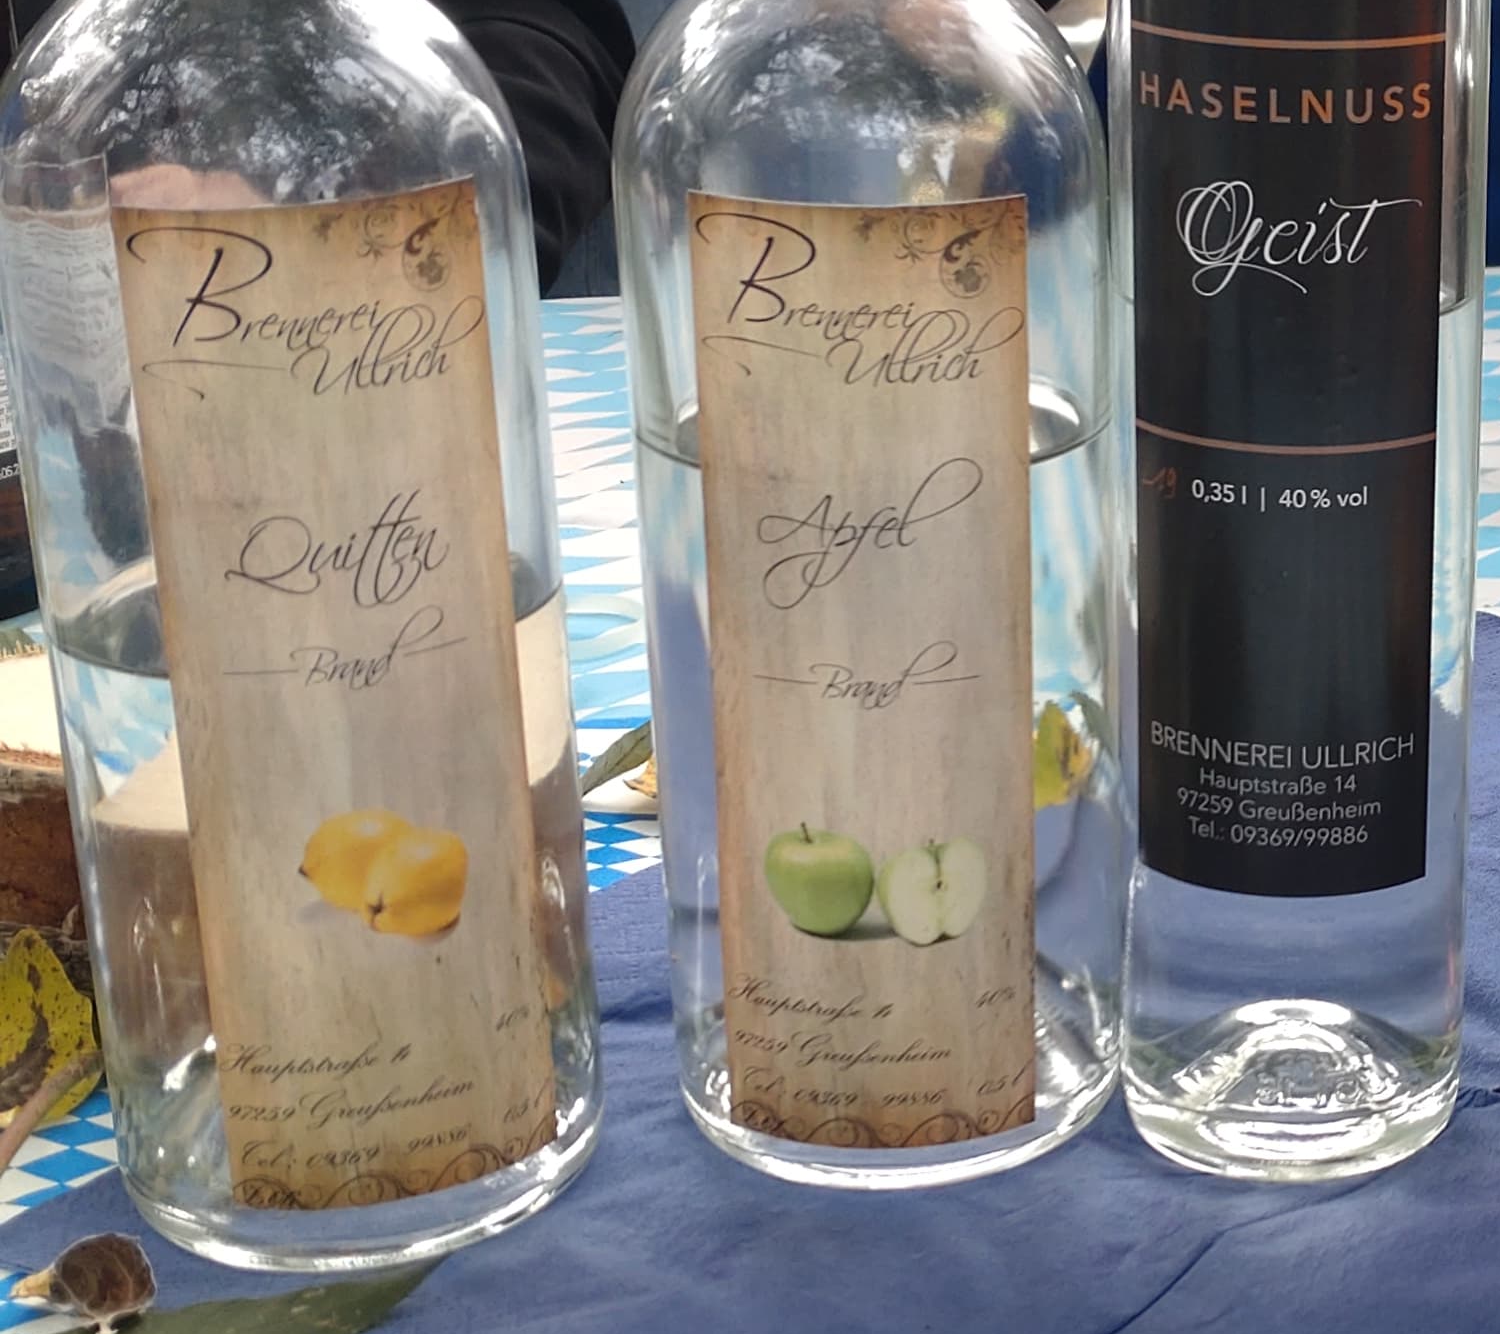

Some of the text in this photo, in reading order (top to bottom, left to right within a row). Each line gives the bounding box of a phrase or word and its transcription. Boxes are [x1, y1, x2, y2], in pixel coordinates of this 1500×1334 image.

[1139, 71, 1432, 124] HASELNUSS
[695, 211, 915, 342] Brennerei
[1176, 180, 1423, 297] Geist
[126, 227, 380, 351] Brennerei
[288, 295, 486, 397] Ullrich
[825, 306, 1026, 388] Ullrich
[757, 457, 984, 611] Apfel
[1191, 478, 1237, 506] 0,35
[1336, 485, 1369, 508] vol
[224, 488, 452, 609] Quitten
[1151, 720, 1415, 769] BRENNEREI ULLRICH
[1199, 767, 1358, 797] Hauptstraße 14
[1176, 786, 1382, 823] 97259 Greußenheim
[1229, 823, 1370, 848] 09369/99886
